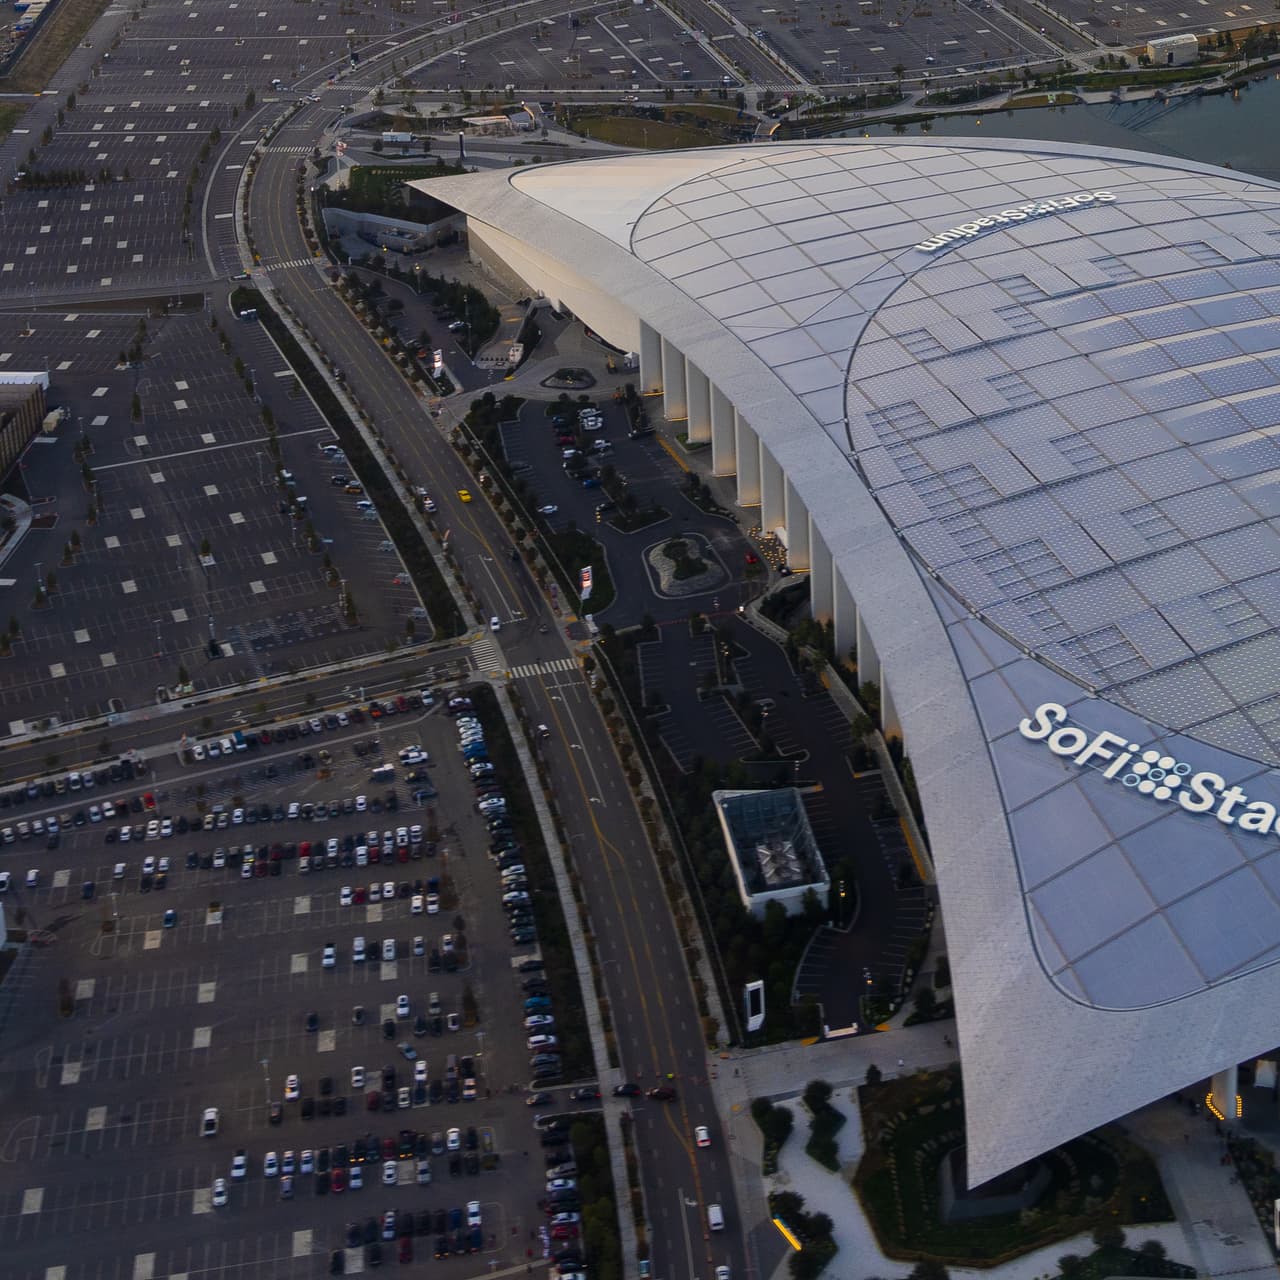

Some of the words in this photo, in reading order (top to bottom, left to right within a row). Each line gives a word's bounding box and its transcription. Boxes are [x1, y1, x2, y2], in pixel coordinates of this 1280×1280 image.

[1047, 191, 1117, 210] SoFi
[914, 208, 1028, 253] Stadium
[1018, 702, 1140, 780] SoFi
